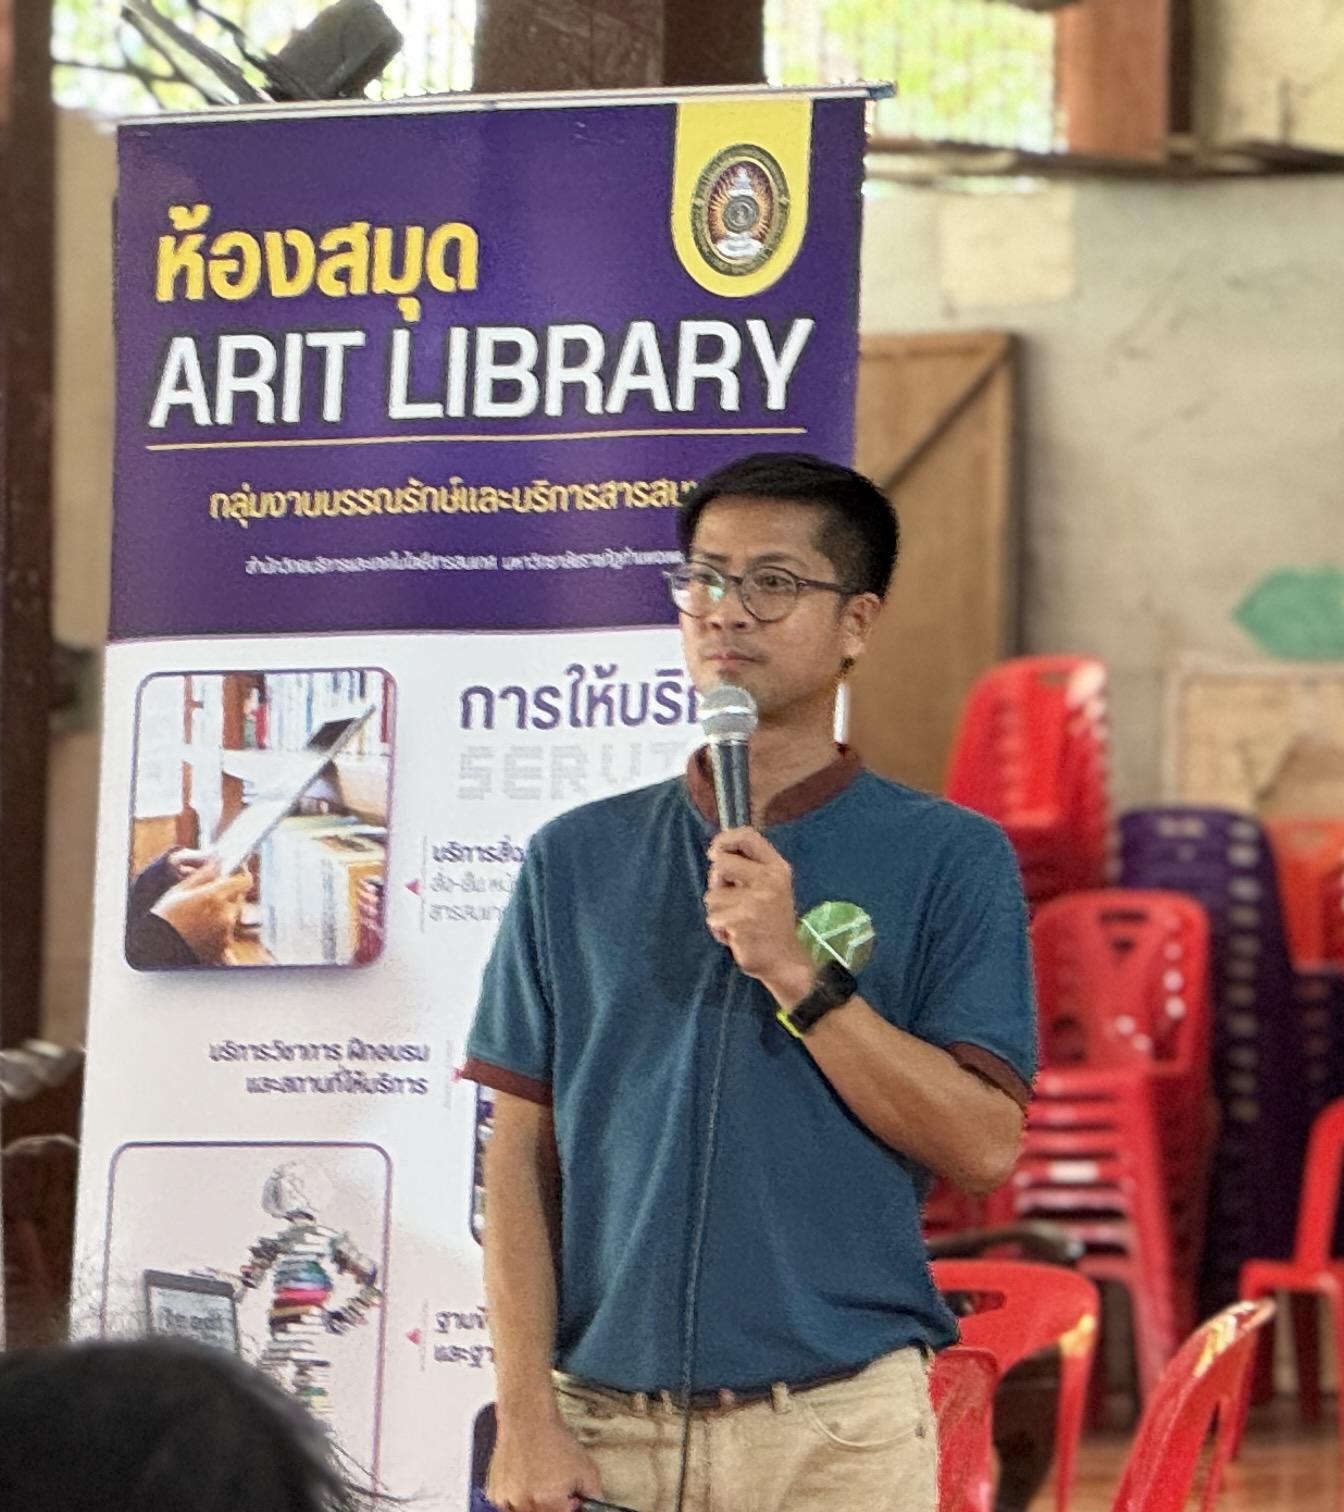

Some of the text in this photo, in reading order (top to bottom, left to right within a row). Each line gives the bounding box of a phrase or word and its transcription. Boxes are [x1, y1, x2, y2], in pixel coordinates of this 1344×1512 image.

[154, 202, 478, 322] ห้องสมุด
[147, 318, 816, 429] ARIT LIBRARY
